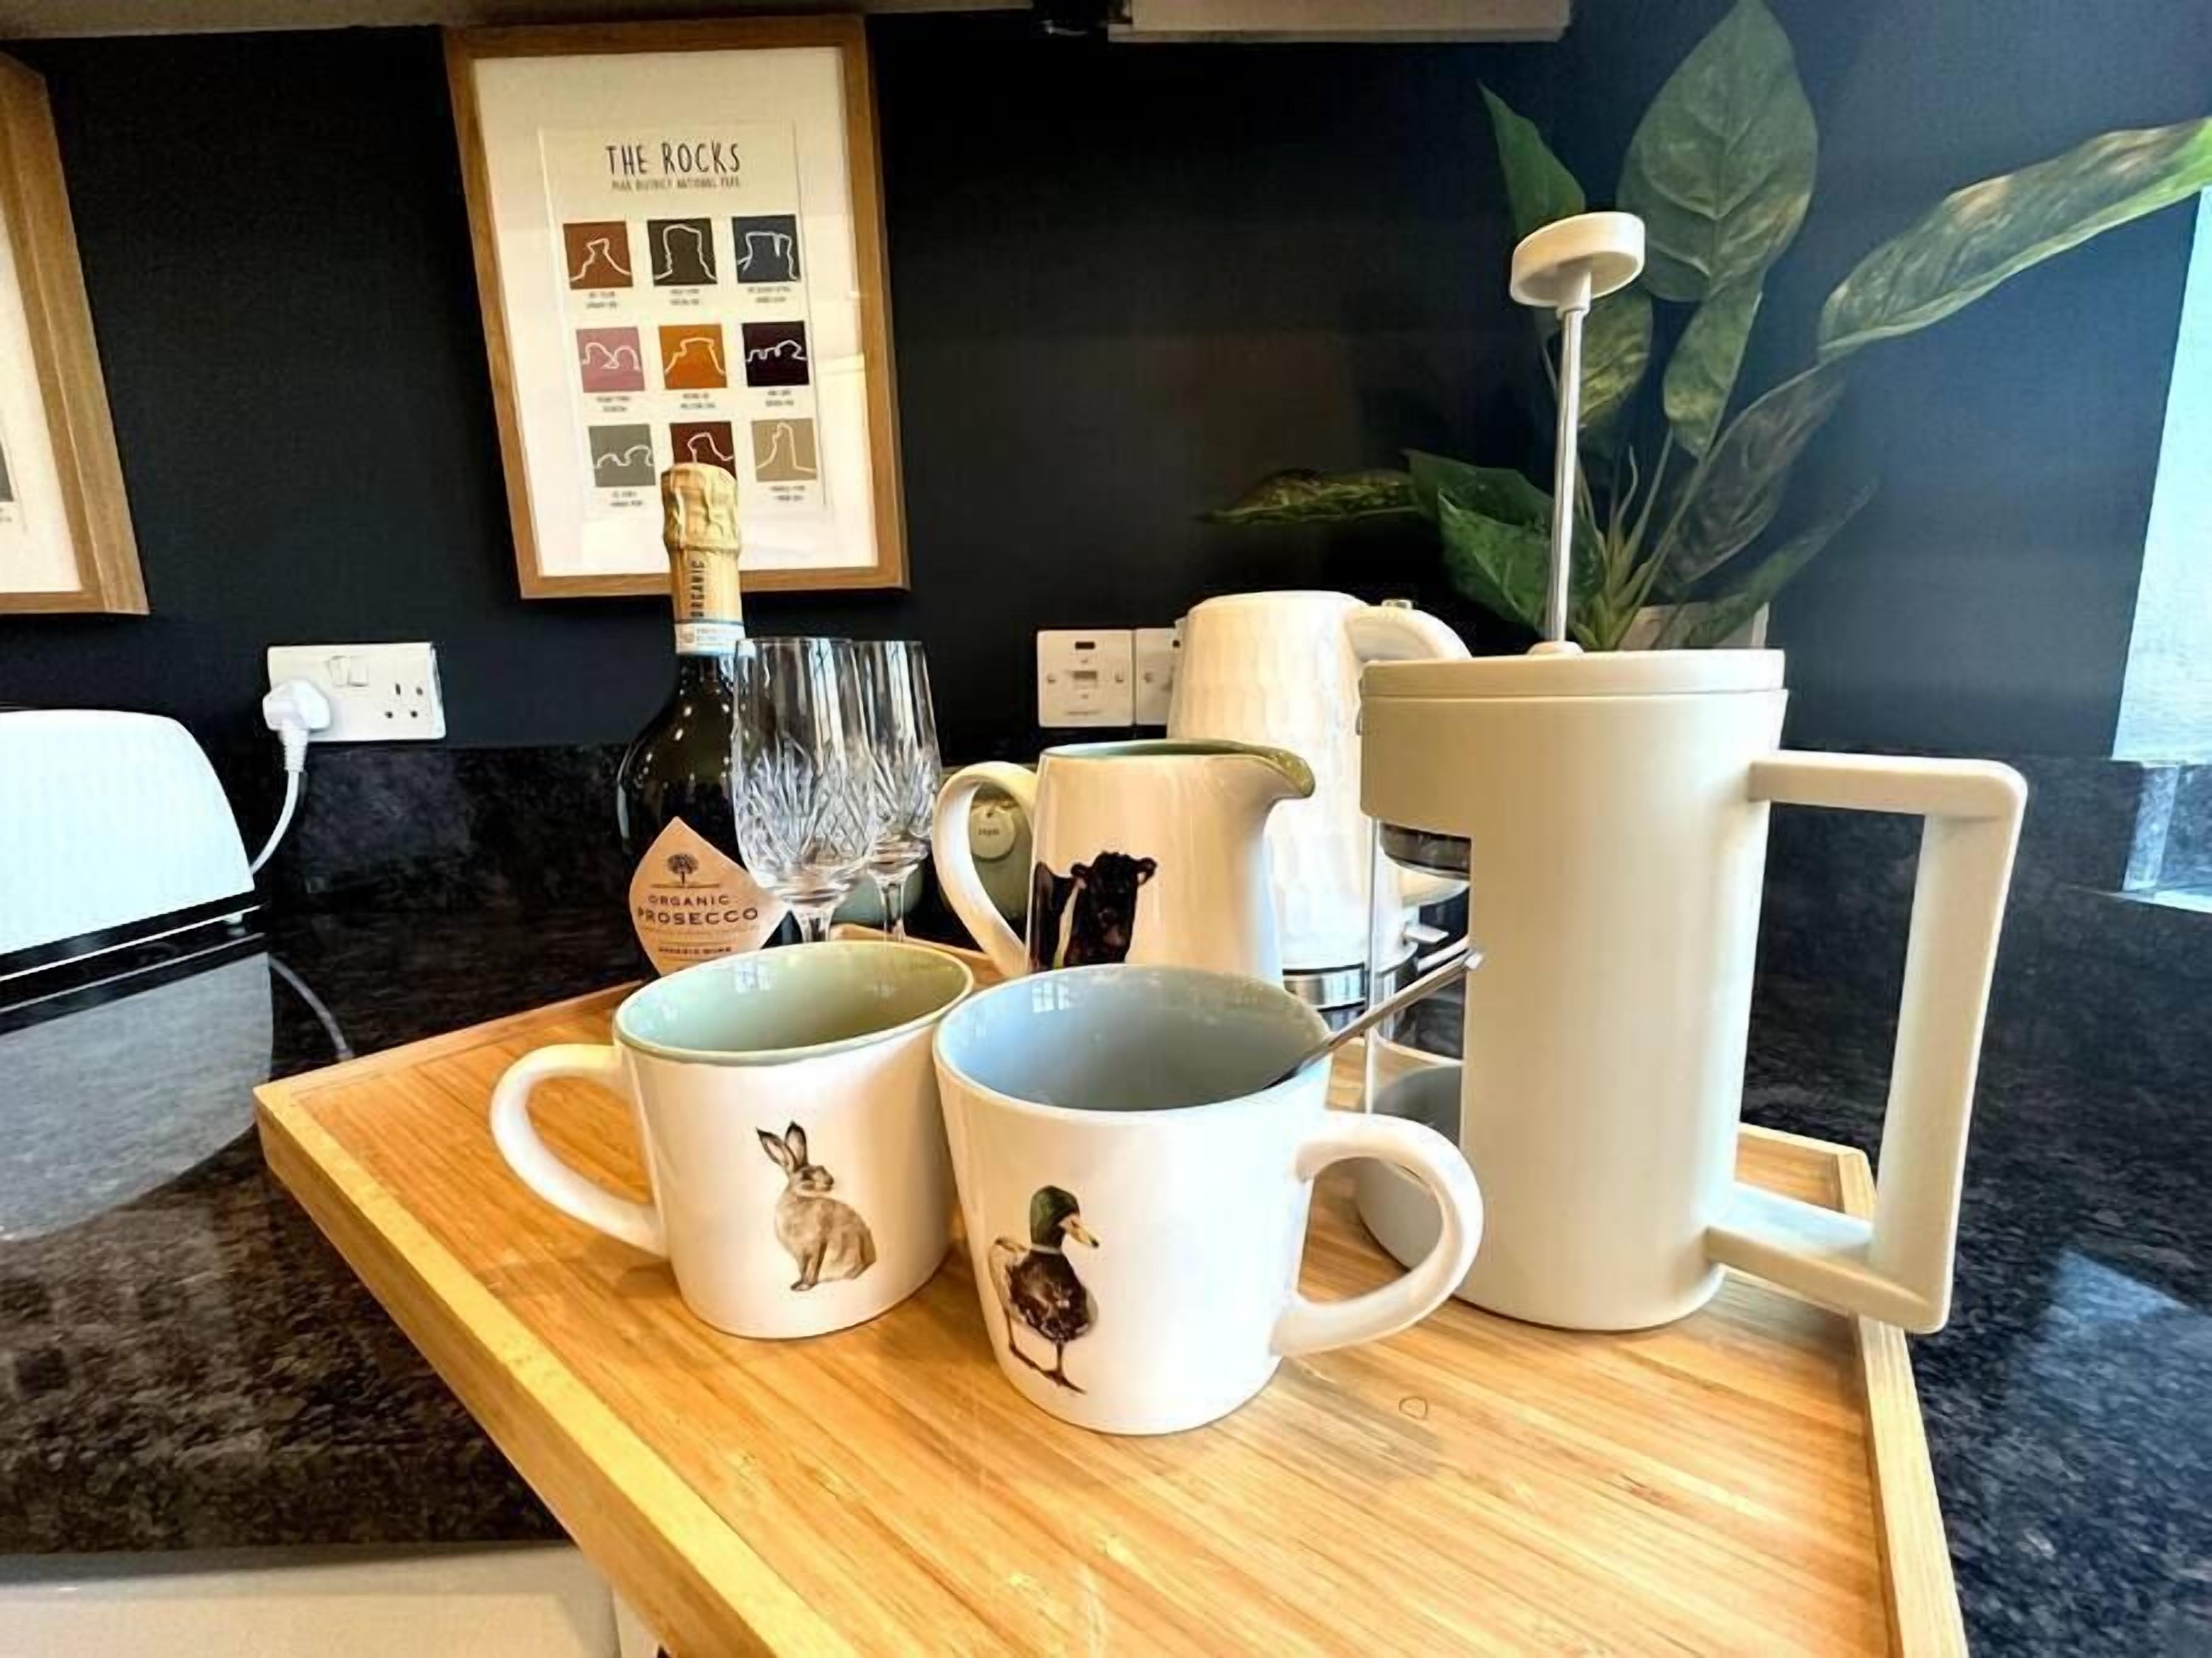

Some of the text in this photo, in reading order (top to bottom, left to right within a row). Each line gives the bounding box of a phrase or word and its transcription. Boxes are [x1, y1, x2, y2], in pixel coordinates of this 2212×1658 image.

[605, 141, 740, 175] THE ROCKS
[648, 895, 730, 907] ORGANIC
[638, 907, 758, 925] PROSECCO
